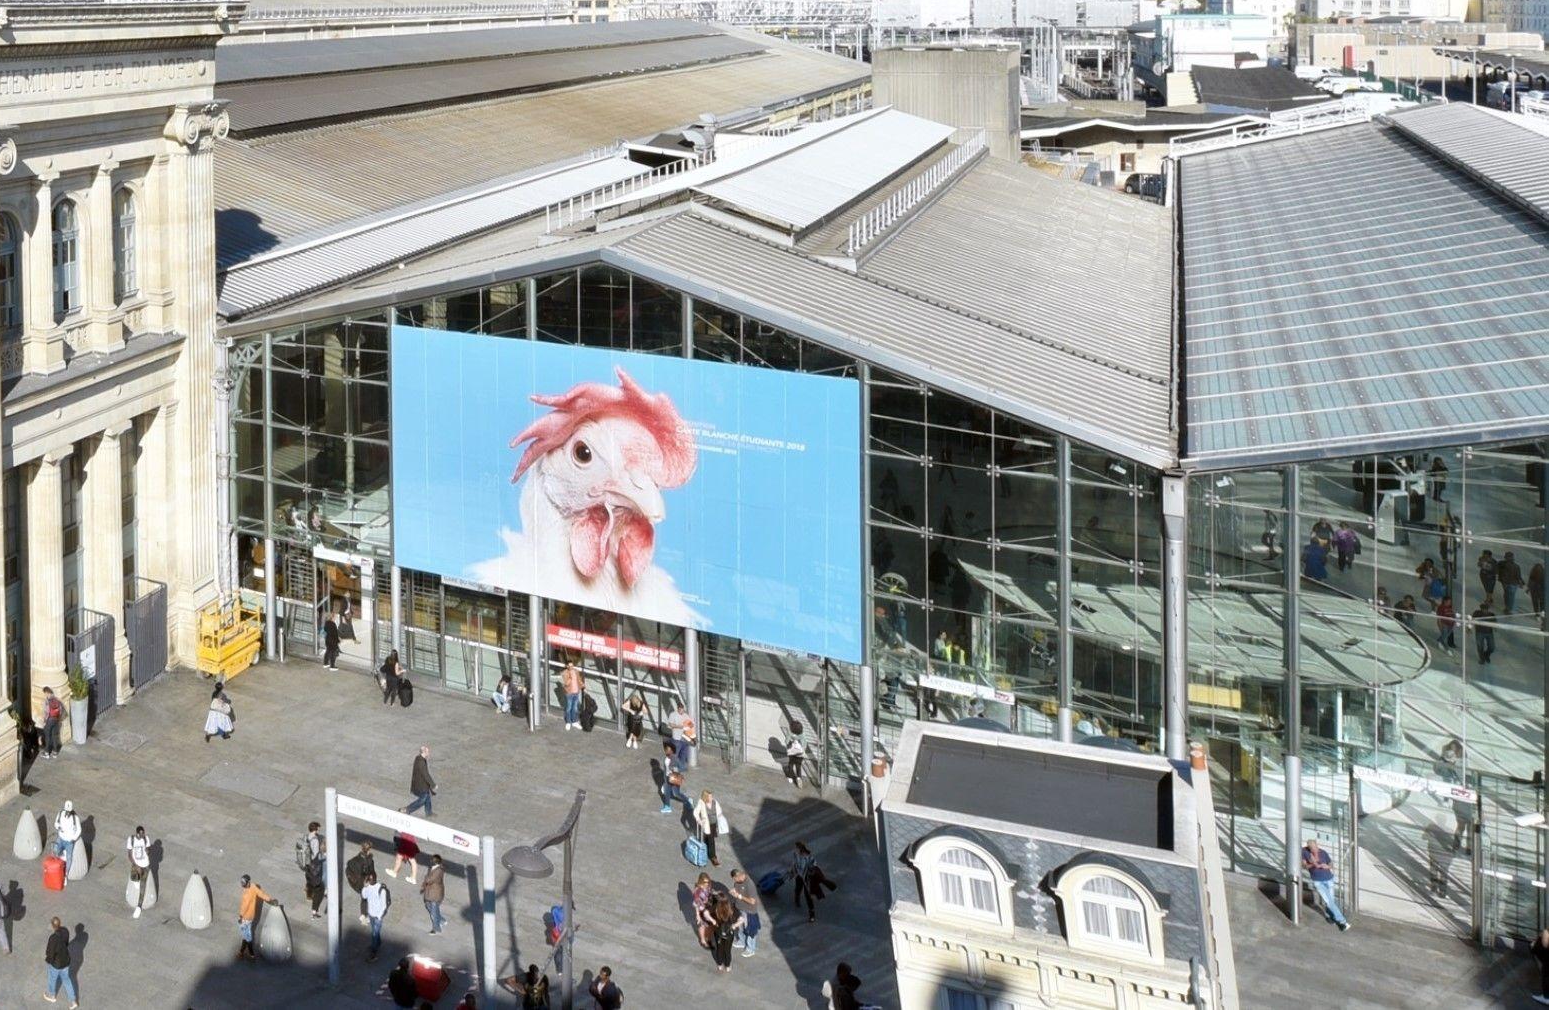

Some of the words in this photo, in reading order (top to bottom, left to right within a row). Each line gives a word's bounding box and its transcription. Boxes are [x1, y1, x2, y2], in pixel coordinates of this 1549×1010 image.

[63, 65, 84, 90] DE
[92, 62, 124, 87] FER
[132, 60, 151, 84] DU
[157, 56, 195, 81] NORD
[701, 430, 739, 442] BLANCHE
[345, 801, 366, 814] GARE
[386, 813, 411, 829] NORD
